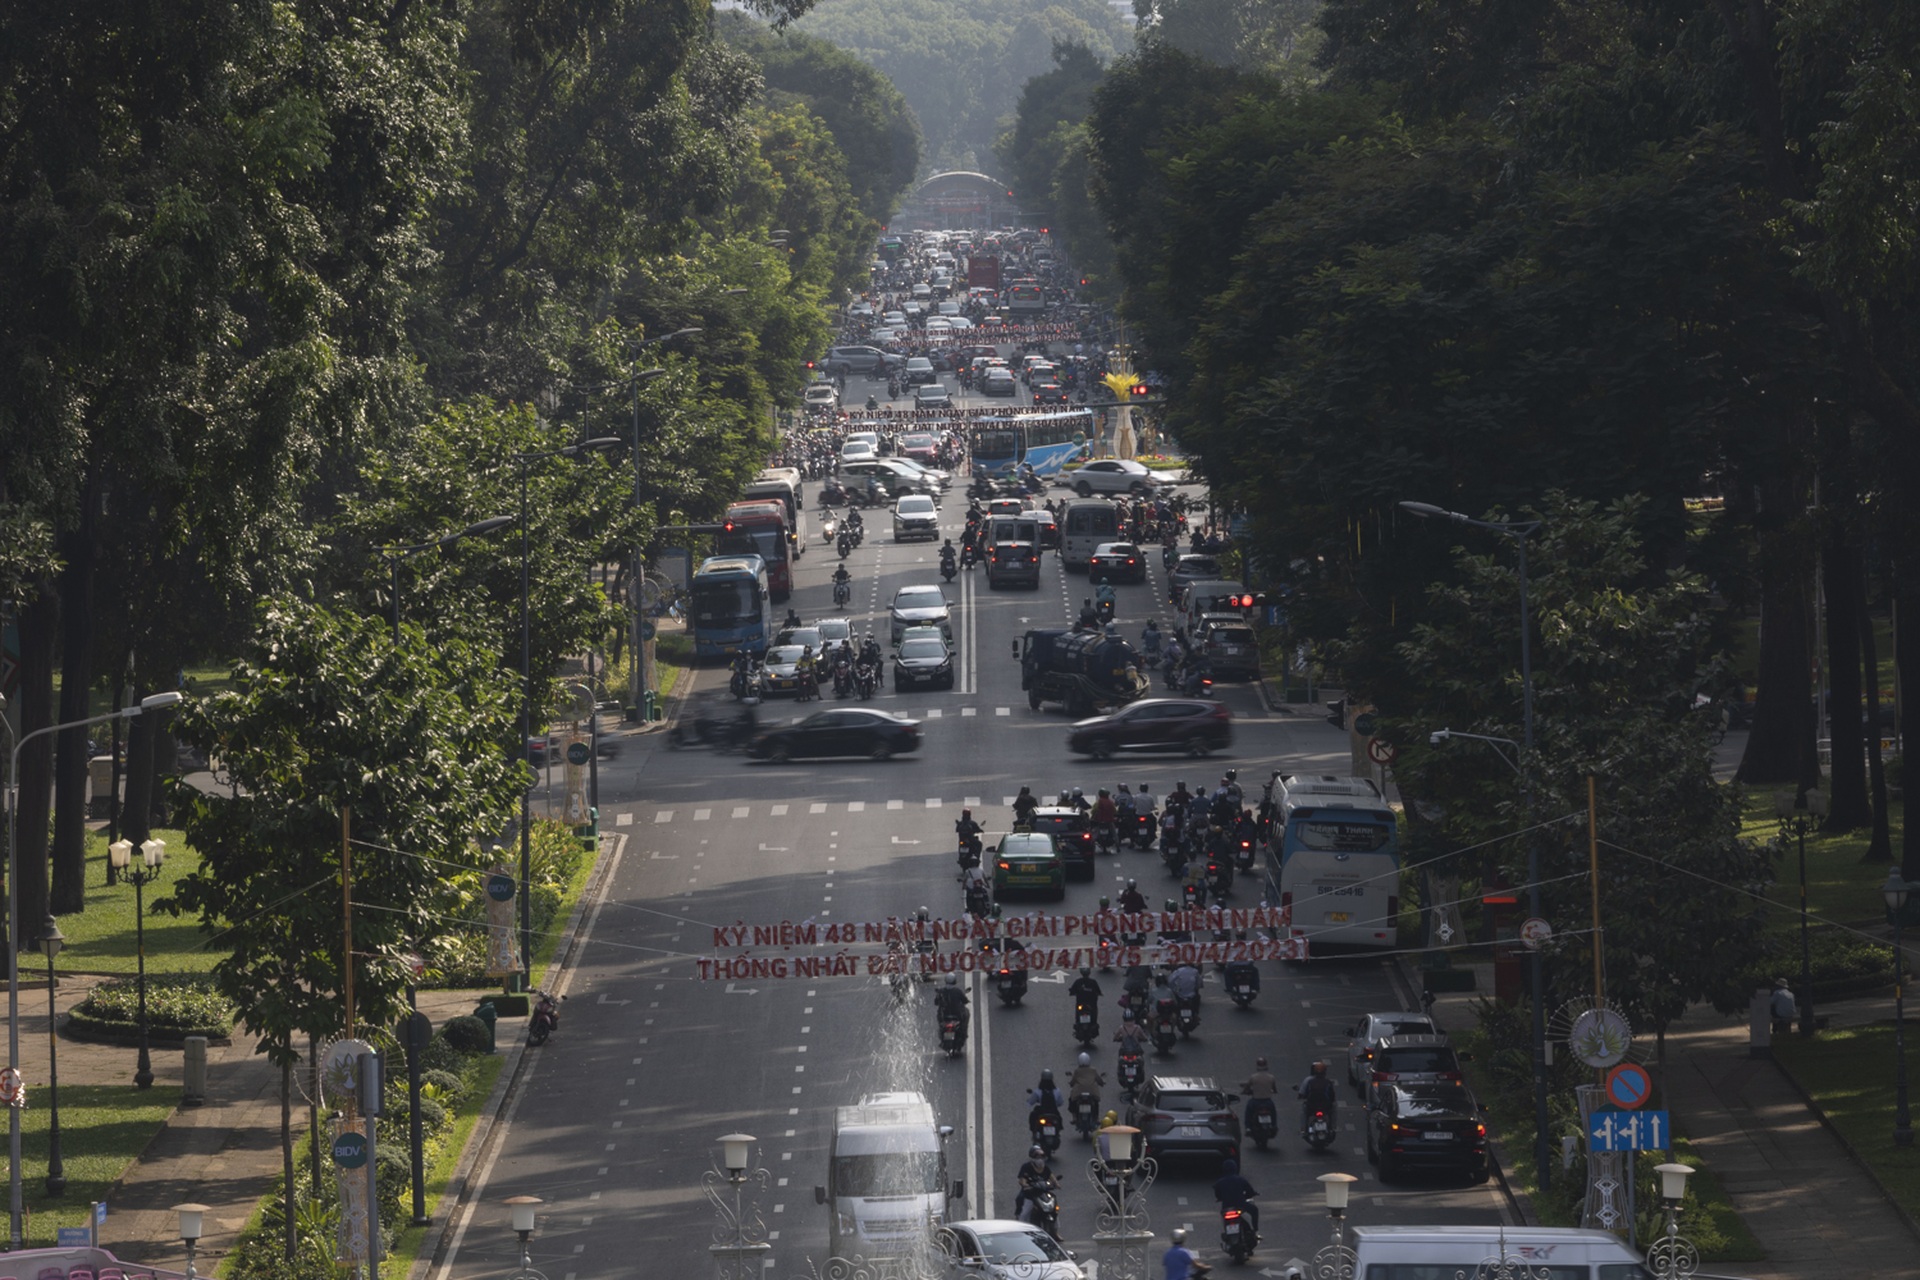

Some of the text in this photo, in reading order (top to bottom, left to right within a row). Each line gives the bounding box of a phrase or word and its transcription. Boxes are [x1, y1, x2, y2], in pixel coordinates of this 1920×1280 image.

[713, 902, 1292, 951] KỶ NIỆM 48 NĂM NGÀY GIẢI PHÓNG MIỀN NAM
[697, 950, 788, 981] THỐNG
[795, 948, 860, 977] NHẤT
[919, 947, 996, 974] NƯỚC
[1003, 944, 1142, 972] (30/4/1975
[1166, 935, 1310, 966] 30/4/2023)
[335, 1145, 361, 1157] BIDV
